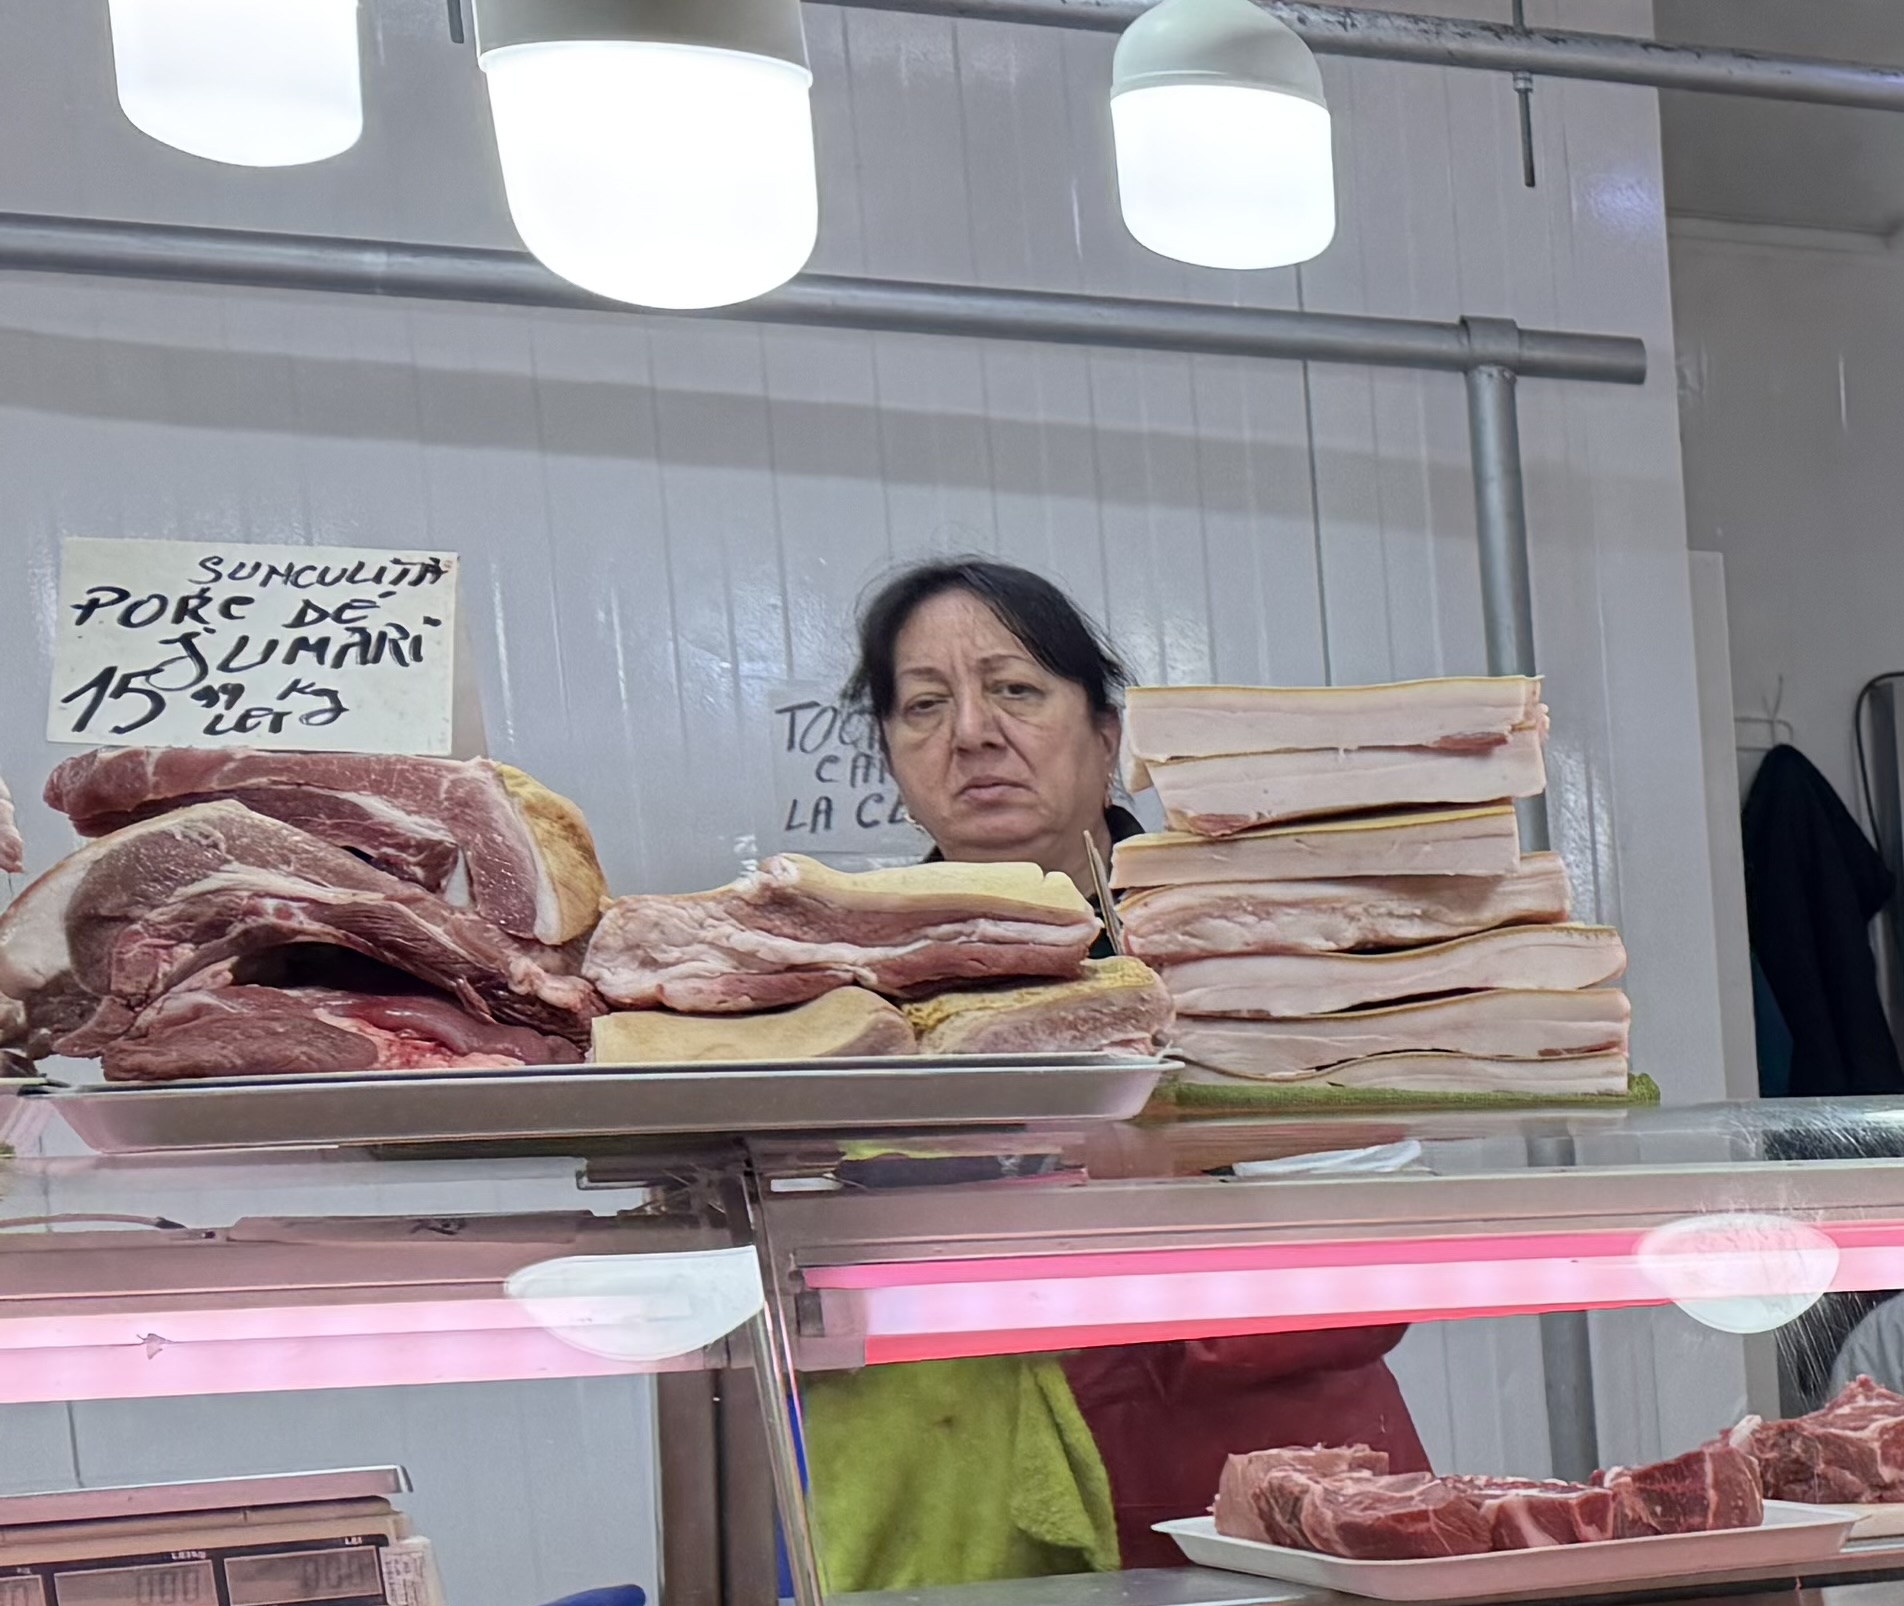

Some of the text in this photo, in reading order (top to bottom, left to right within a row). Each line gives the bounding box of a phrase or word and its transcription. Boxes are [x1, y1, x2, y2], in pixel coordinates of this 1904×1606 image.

[70, 585, 256, 628] PORC
[61, 665, 167, 734] 15
[785, 796, 833, 834] LA
